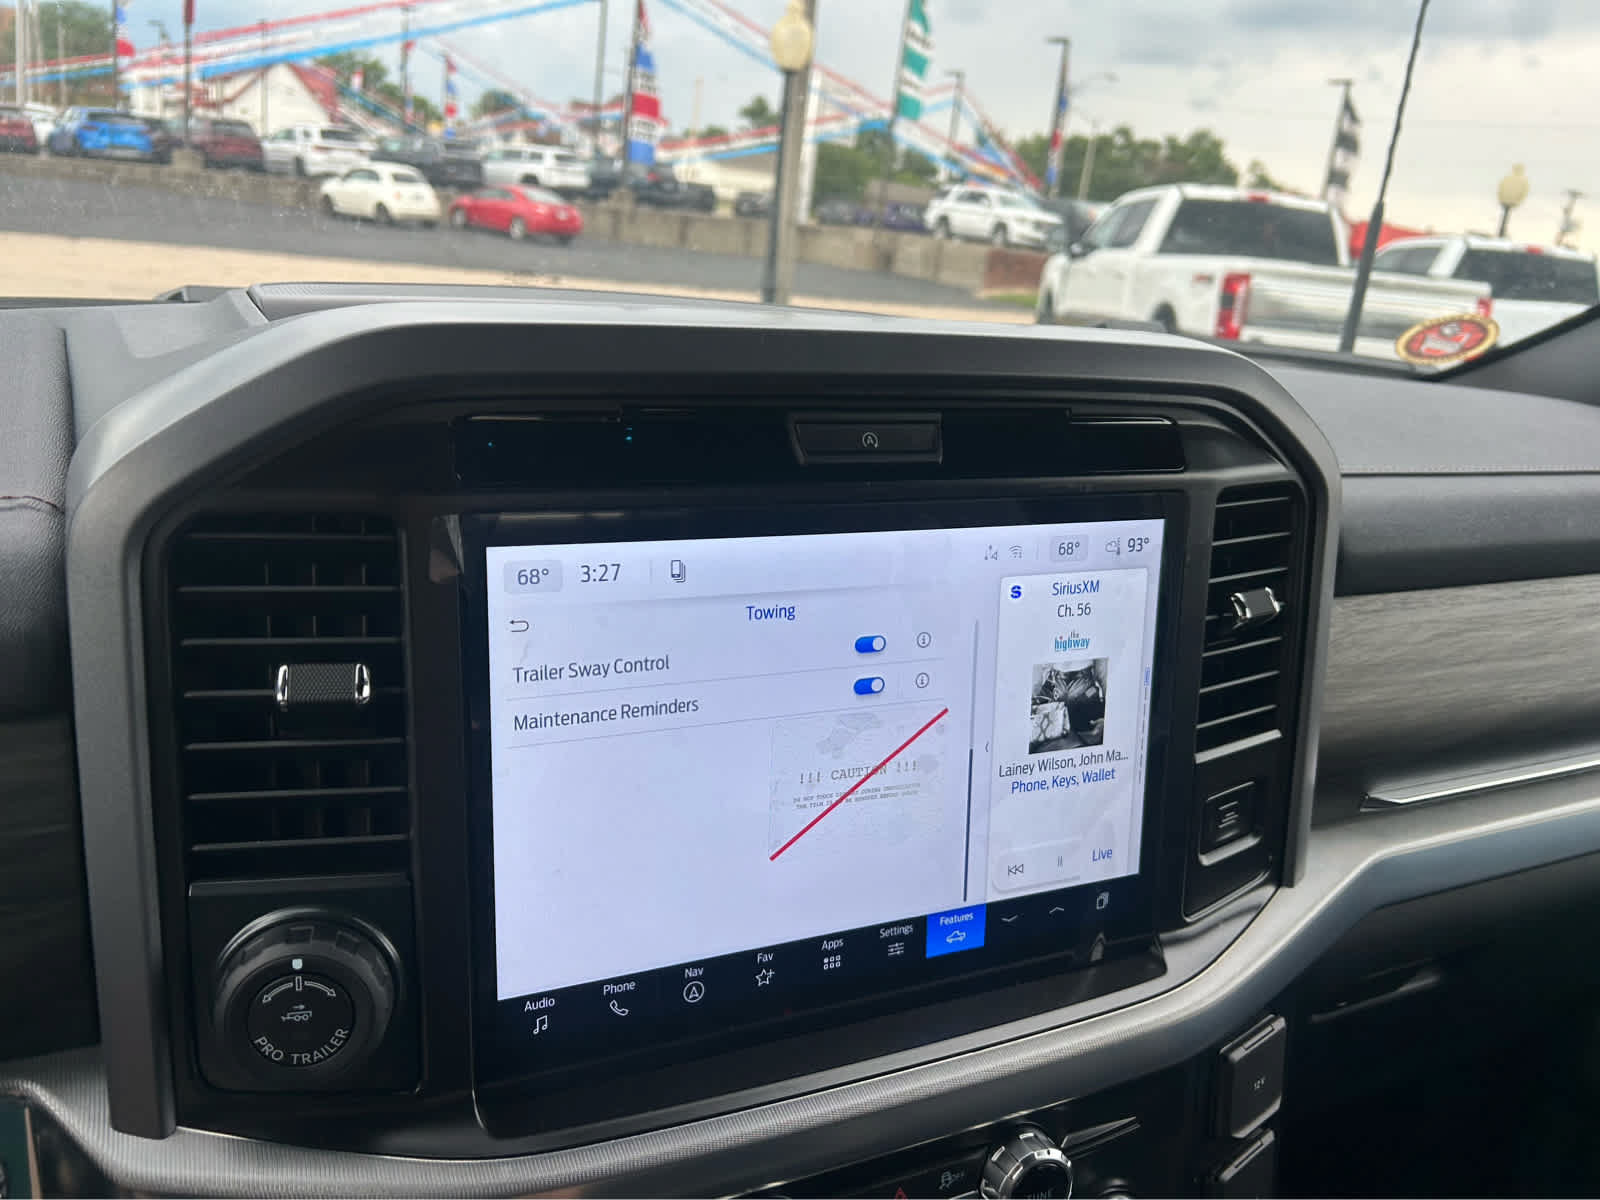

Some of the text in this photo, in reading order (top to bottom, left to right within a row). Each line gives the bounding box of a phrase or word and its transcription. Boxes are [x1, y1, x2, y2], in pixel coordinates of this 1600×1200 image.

[1058, 541, 1081, 556] 68°
[1127, 537, 1150, 552] 93°
[517, 568, 549, 586] 68°
[580, 563, 621, 583] 3:27
[1052, 580, 1100, 596] SiriusXM
[746, 604, 796, 622] Towing
[1057, 602, 1092, 618] Ch. 56
[1054, 635, 1090, 652] highway
[513, 654, 670, 684] Trailer Sway Control
[513, 698, 700, 731] Maintenance Reminders
[831, 764, 888, 780] CAUTIN
[999, 763, 1035, 778] Lainey
[1037, 758, 1077, 773] Wilson,
[1079, 752, 1104, 767] John
[1011, 768, 1116, 795] Phone, Keys, Wallet
[1092, 848, 1113, 862] Live
[939, 911, 974, 926] Features
[879, 924, 914, 939] Settings
[821, 938, 844, 951] Apps
[757, 952, 774, 963] Fav
[684, 967, 704, 979] Nav
[603, 981, 636, 996] Phone
[524, 997, 556, 1012] Audio
[254, 1028, 349, 1065] PRO TRAILER
